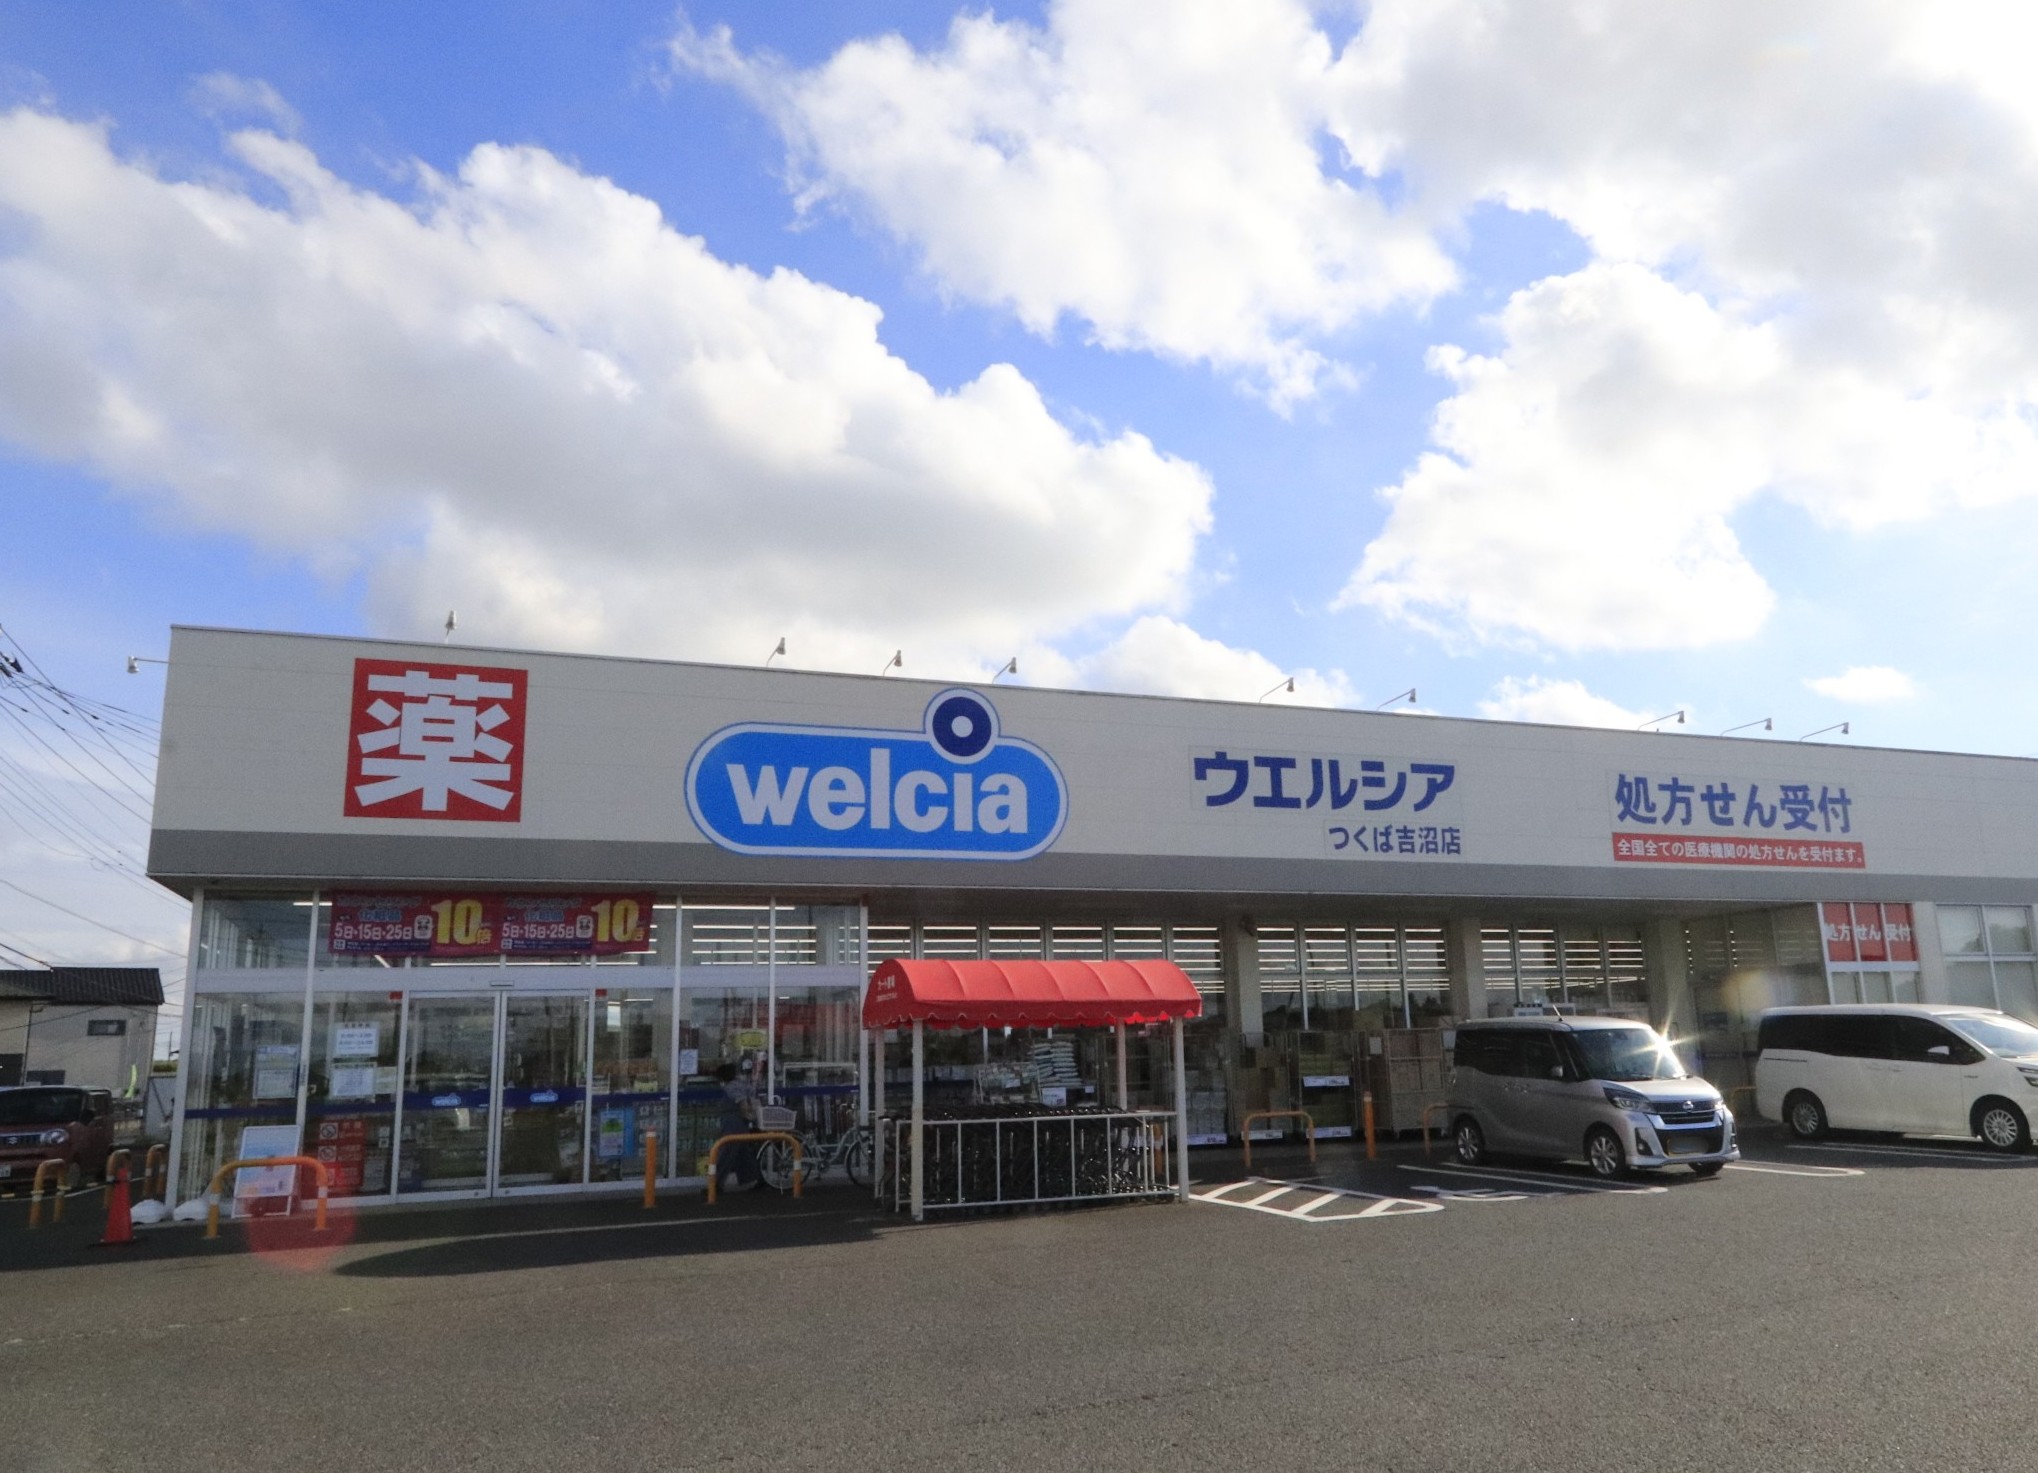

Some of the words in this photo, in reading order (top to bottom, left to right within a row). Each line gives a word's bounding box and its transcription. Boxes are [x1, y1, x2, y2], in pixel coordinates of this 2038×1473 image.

[353, 669, 515, 812] 薬
[725, 697, 1029, 834] welcia
[1193, 751, 1455, 812] ウエルシア
[1614, 773, 1852, 834] 処方せん受付
[1328, 824, 1462, 855] つくば吉沼店
[1617, 837, 1864, 865] 全国全ての医療機関の処方せんを受付ます。
